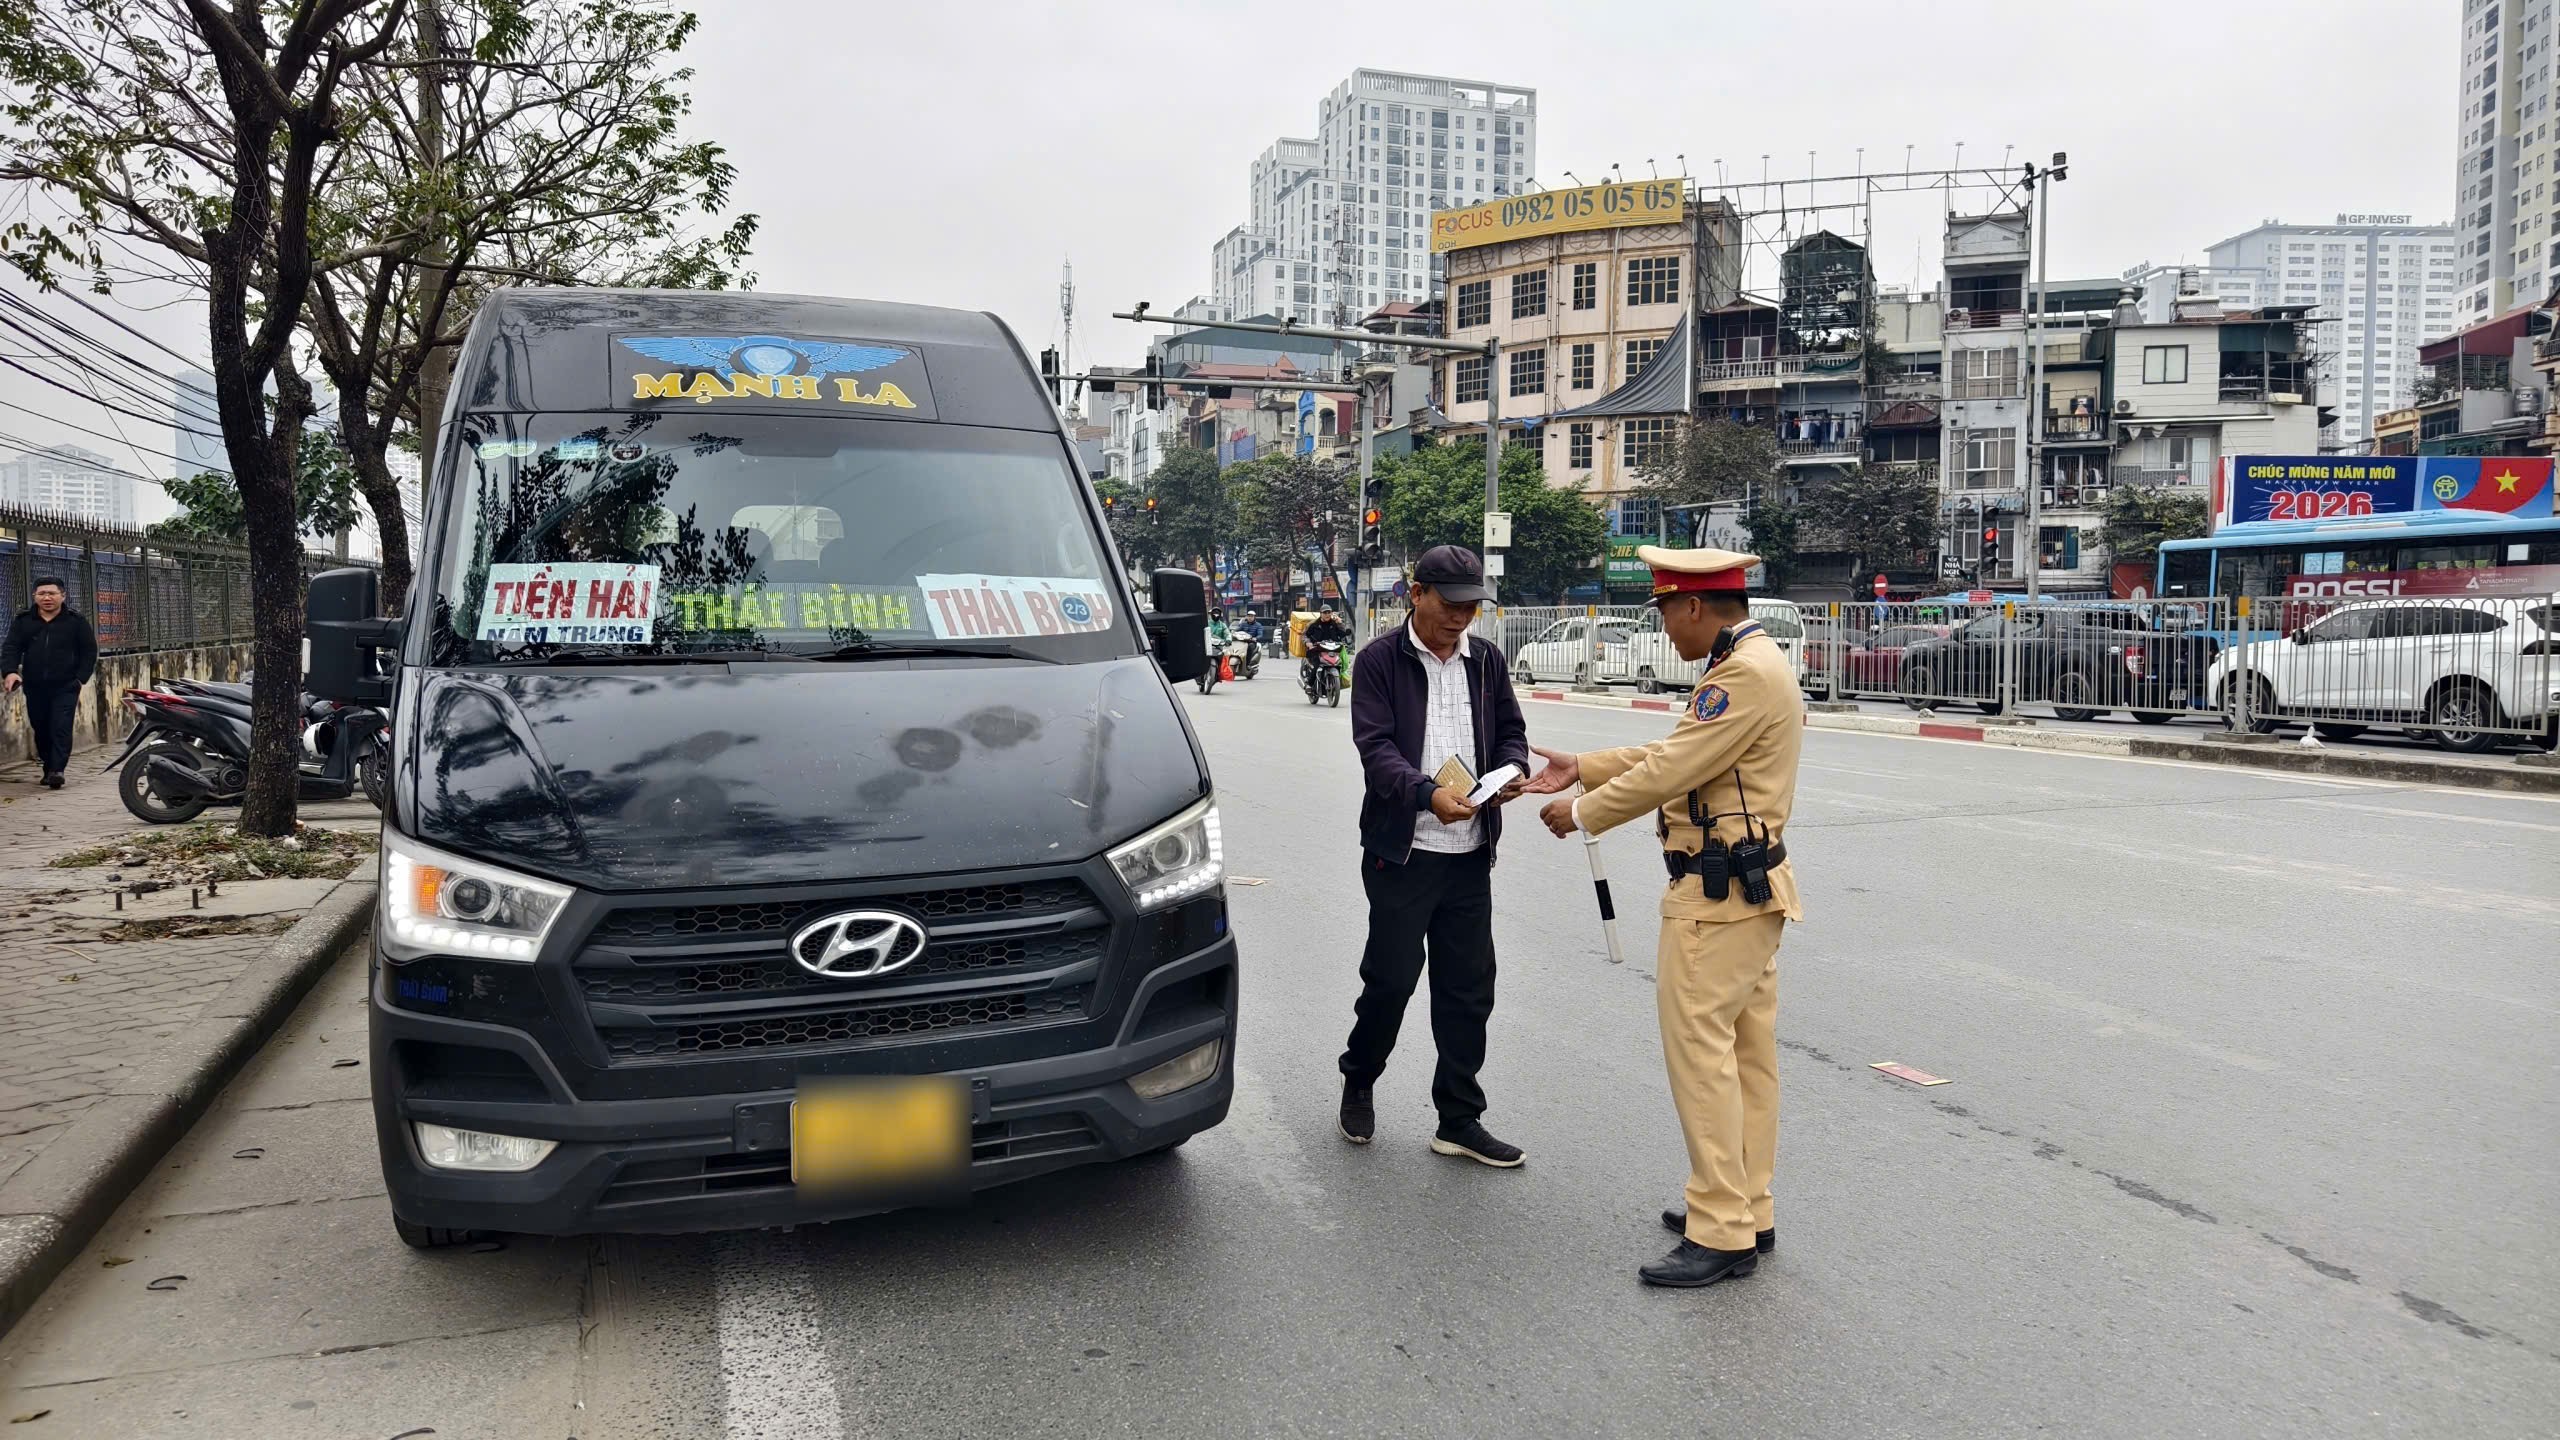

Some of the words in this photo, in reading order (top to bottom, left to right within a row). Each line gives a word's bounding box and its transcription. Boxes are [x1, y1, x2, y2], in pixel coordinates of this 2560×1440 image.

[1437, 210, 1493, 235] FOCUS
[1502, 195, 1554, 227] 0982
[1564, 190, 1594, 217] 05
[1603, 186, 1634, 213] 05
[1644, 182, 1676, 210] 05
[632, 373, 822, 403] MẠNH
[834, 378, 917, 408] LA
[2248, 464, 2285, 478] CHÚC
[2288, 464, 2330, 479] MỪNG
[2333, 465, 2365, 479] NĂM
[2369, 465, 2396, 480] MỚI
[2268, 490, 2373, 521] 2026
[494, 565, 577, 619] TIỀN
[586, 564, 652, 618] HẢI
[673, 582, 786, 631] THÁI
[802, 583, 911, 629] BÌNH
[928, 579, 1026, 636] THÁI
[2293, 579, 2400, 606] ROSSI
[1065, 603, 1088, 616] 2/3
[486, 626, 548, 643] NAM
[557, 625, 644, 643] TRUNG
